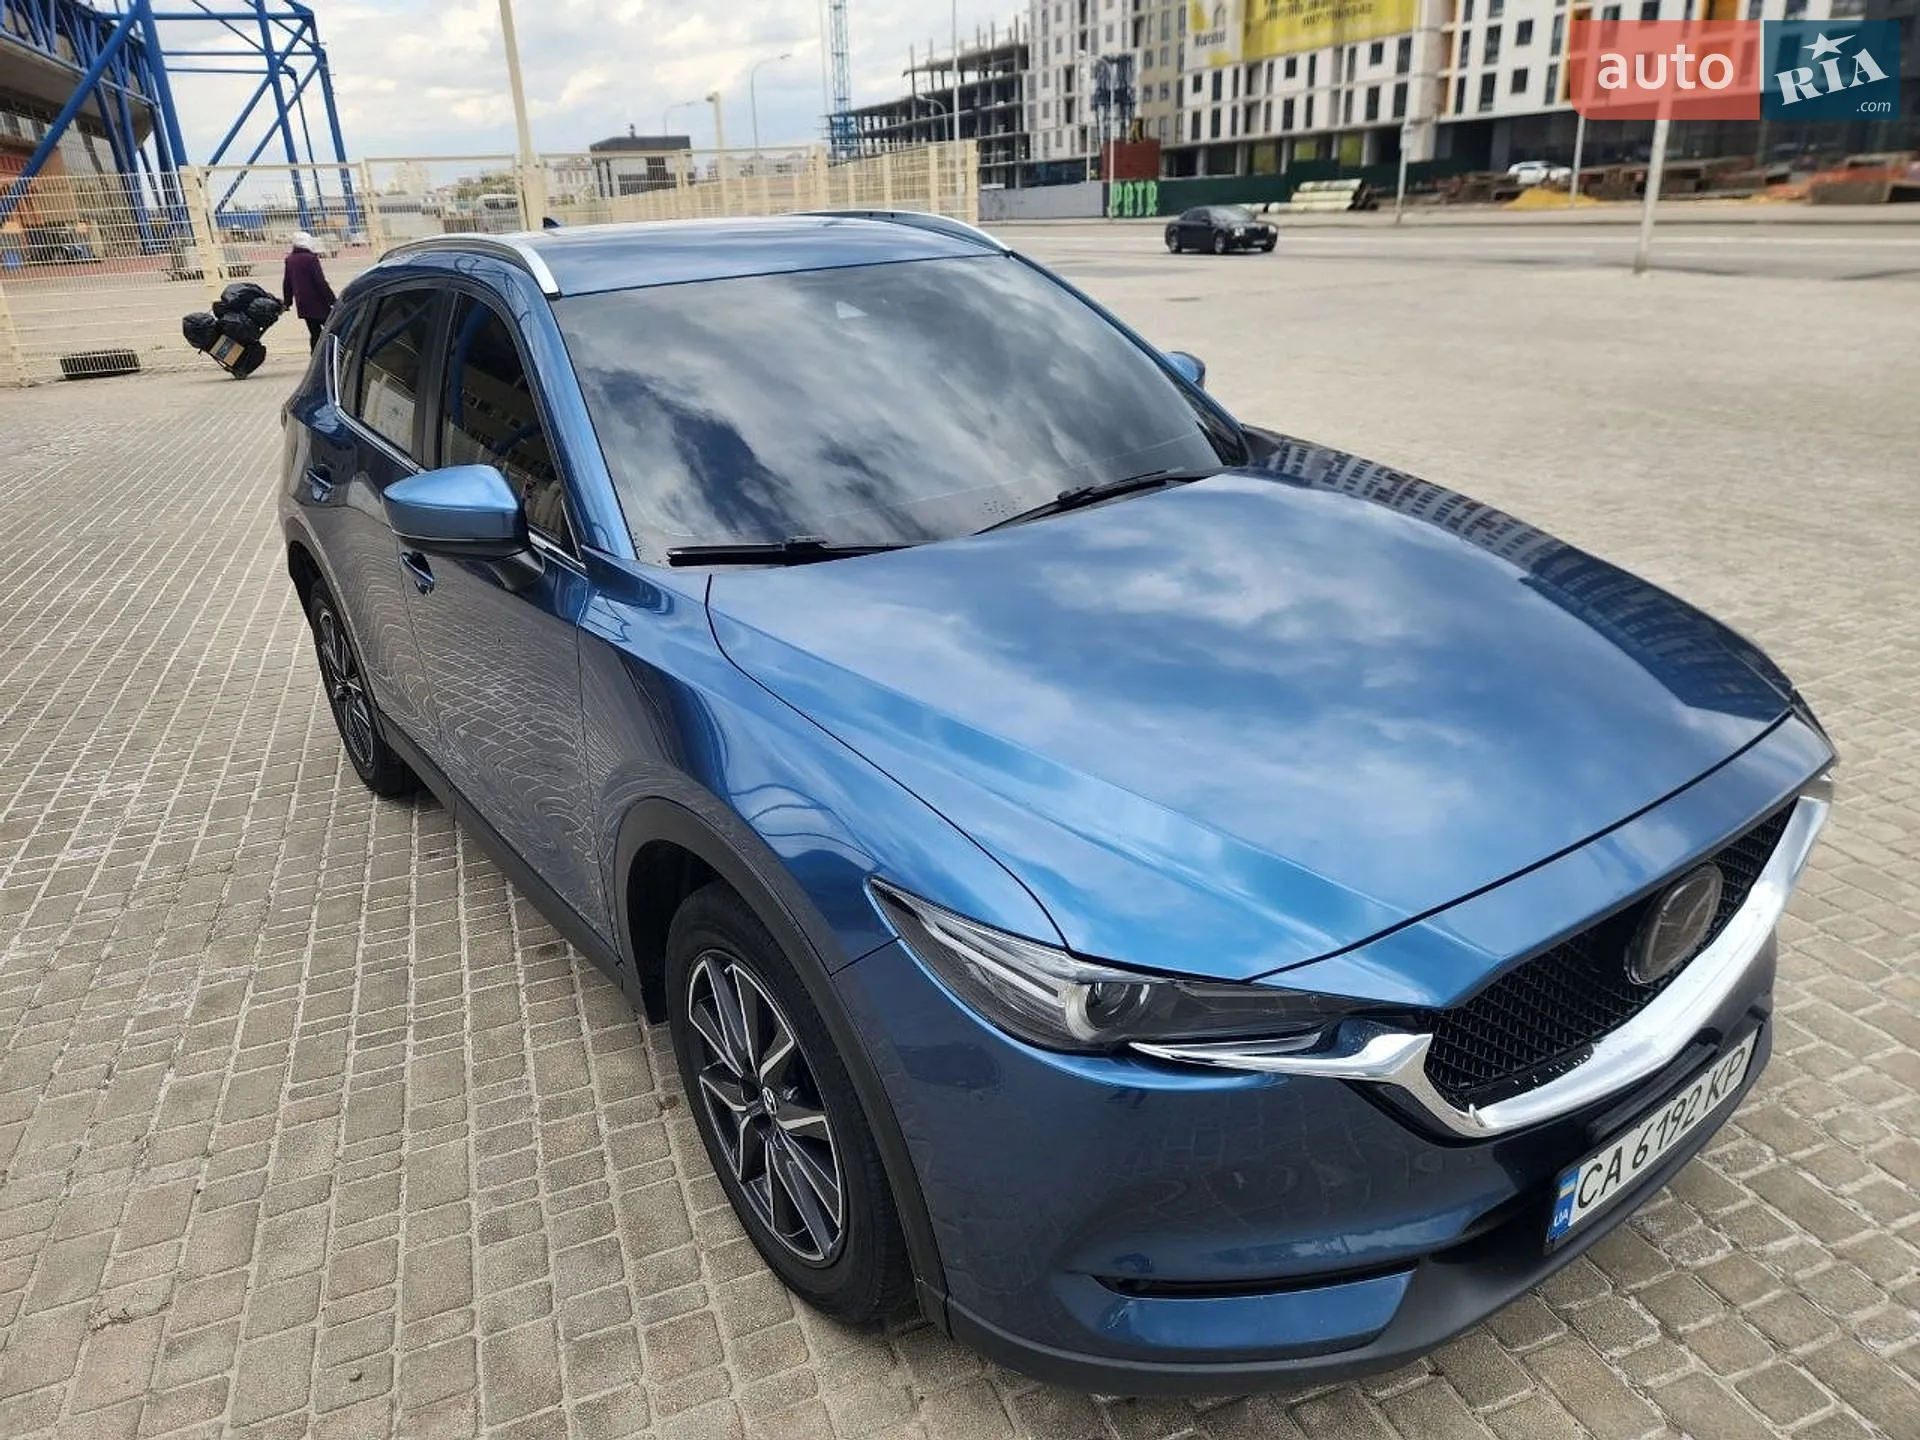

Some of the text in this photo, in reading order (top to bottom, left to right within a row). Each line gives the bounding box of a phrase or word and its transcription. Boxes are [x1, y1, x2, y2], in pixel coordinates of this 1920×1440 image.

[1578, 1047, 1746, 1209] CA 6192 KP
